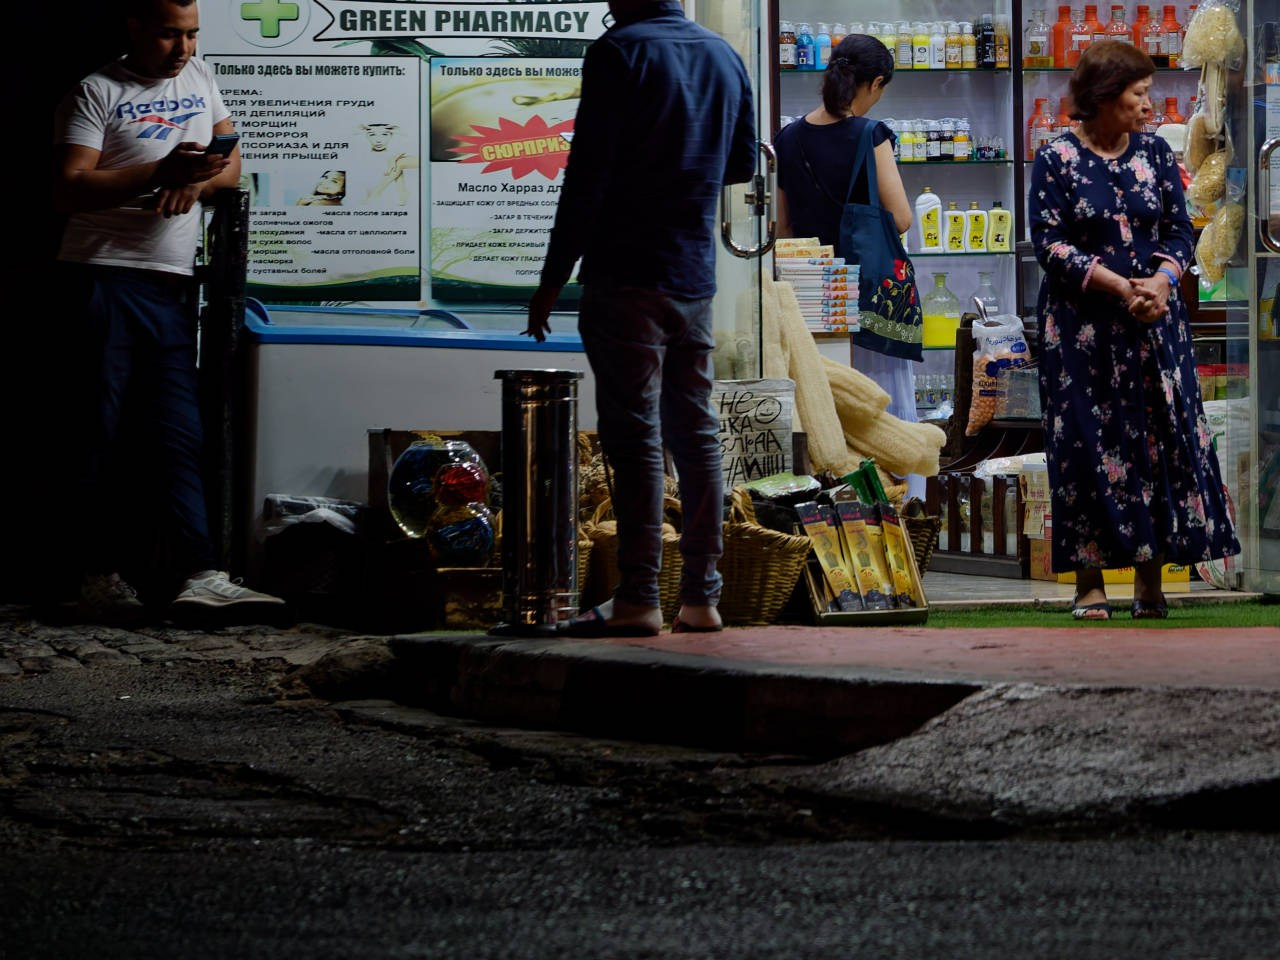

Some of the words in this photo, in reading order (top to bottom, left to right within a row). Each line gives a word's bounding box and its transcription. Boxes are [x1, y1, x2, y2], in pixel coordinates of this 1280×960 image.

[340, 7, 428, 34] GREEN
[434, 8, 590, 35] PHARMACY
[214, 62, 254, 76] Только
[257, 64, 293, 78] здесь
[295, 64, 312, 76] вы
[315, 64, 359, 77] можете
[362, 64, 406, 78] купить:
[439, 64, 484, 77] Только
[485, 65, 523, 78] здесь
[525, 66, 543, 77] вы
[116, 94, 207, 121] Reebok
[250, 99, 334, 108] УВЕЛИЧЕНИЯ
[337, 99, 376, 109] ГРУДИ
[230, 110, 247, 118] ЛЯ
[249, 108, 326, 119] ДЕПИЛЯЦИЙ
[241, 121, 298, 130] МОРЩИН
[241, 131, 309, 140] ГЕМОРРОЯ
[241, 141, 310, 150] ПСОРИАЗА
[312, 142, 321, 150] И
[323, 142, 350, 151] ДЛЯ
[282, 150, 339, 162] ПРЫЩЕЙ
[458, 181, 498, 194] Масло
[500, 182, 544, 196] Харраз
[546, 183, 564, 195] дл
[476, 199, 495, 207] КОЖУ
[496, 199, 506, 207] ОТ
[507, 199, 539, 207] ВРЕДНЫХ
